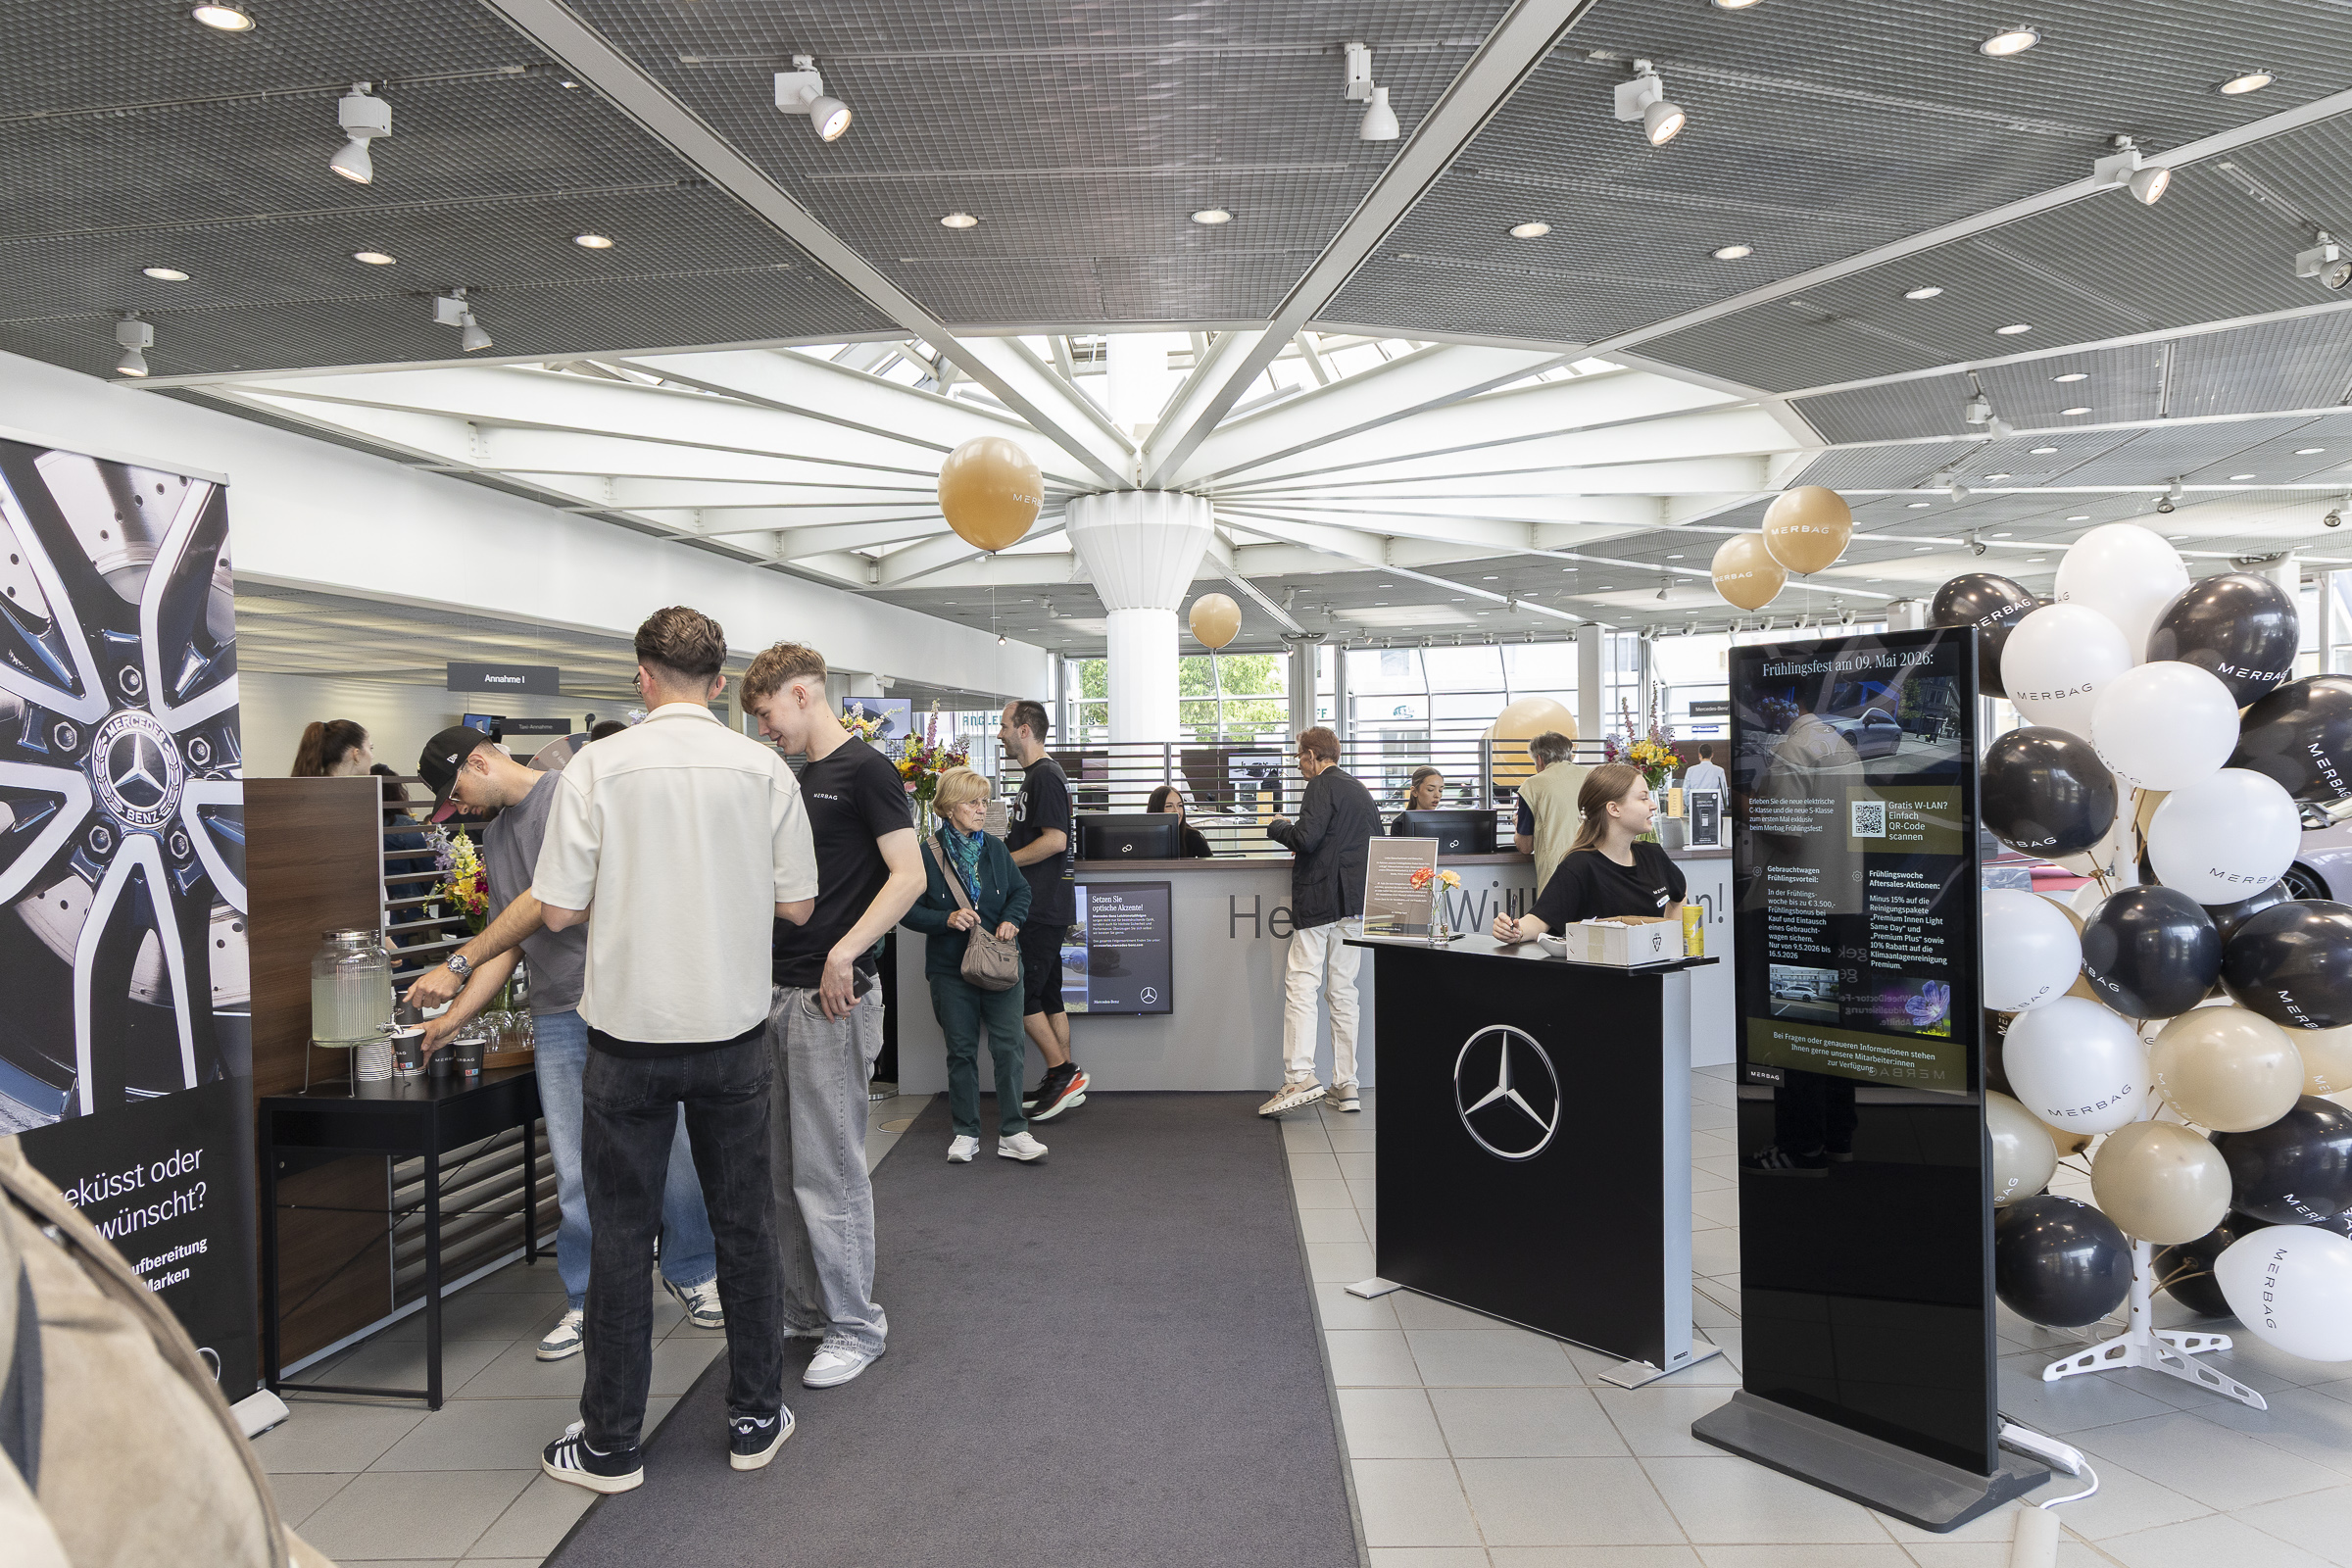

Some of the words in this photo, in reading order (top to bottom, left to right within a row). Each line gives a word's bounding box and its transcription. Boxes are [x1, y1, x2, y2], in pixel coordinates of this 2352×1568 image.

[1012, 493, 1043, 509] MERB
[1771, 525, 1830, 536] MERBAG
[1763, 660, 1833, 677] Frühlingsfest
[1836, 661, 1852, 671] am
[1855, 656, 1872, 669] 09.
[1875, 654, 1897, 668] Mai
[1899, 651, 1934, 666] 2026:
[2218, 662, 2288, 681] MERBAG
[484, 674, 521, 684] Annahme
[2017, 683, 2093, 701] MERBAG
[962, 715, 1002, 726] ANGLE
[105, 715, 167, 744] MERCEDES
[2308, 743, 2352, 798] MERBAG
[1888, 801, 1913, 809] Gratis
[1914, 801, 1948, 809] W-LAN?
[126, 808, 160, 823] BENZ
[2004, 836, 2057, 848] RBAG
[1767, 865, 1820, 874] Gebrauchtwagen
[1869, 870, 1923, 879] Frühlingswoche
[2209, 868, 2284, 884] MERBA
[1767, 874, 1819, 883] Frühlingsvorteil:
[1869, 880, 1940, 889] Aftersales-Aktionen:
[1787, 889, 1817, 899] Frühlings-
[1768, 906, 1814, 915] Frühlingsbonus
[1870, 904, 1930, 914] Reinigungspakete
[1786, 925, 1820, 934] Gebraucht-
[1769, 951, 1798, 959] 16.5.2026
[1871, 951, 1947, 965] Klimaanlagenreinigung
[1871, 960, 1902, 969] Premium.
[2082, 957, 2120, 993] RBAG
[2006, 985, 2050, 1011] RBAG
[2278, 990, 2326, 1031] MERB
[1997, 1008, 2009, 1036] MER
[1773, 1031, 1784, 1040] Bei
[1785, 1033, 1806, 1043] Fragen
[1807, 1036, 1822, 1045] oder
[1823, 1039, 1858, 1051] genaueren
[1859, 1044, 1909, 1057] Informationen
[1910, 1051, 1936, 1060] stehen
[1791, 1044, 1810, 1054] Ihnen
[1811, 1047, 1830, 1056] gerne
[1831, 1050, 1853, 1058] unsere
[1855, 1053, 1915, 1068] Mitarbeiter:innen
[1838, 1060, 1876, 1074] Verfügung.
[1750, 1070, 1780, 1081] MERBAG
[2047, 1084, 2132, 1117] MERBAG
[61, 1163, 145, 1210] eküsst
[150, 1149, 203, 1183] oder
[95, 1181, 207, 1242] wünscht?
[2282, 1193, 2328, 1222] MERB
[130, 1239, 208, 1276] ufbereitung
[2263, 1248, 2288, 1330] MERBAG
